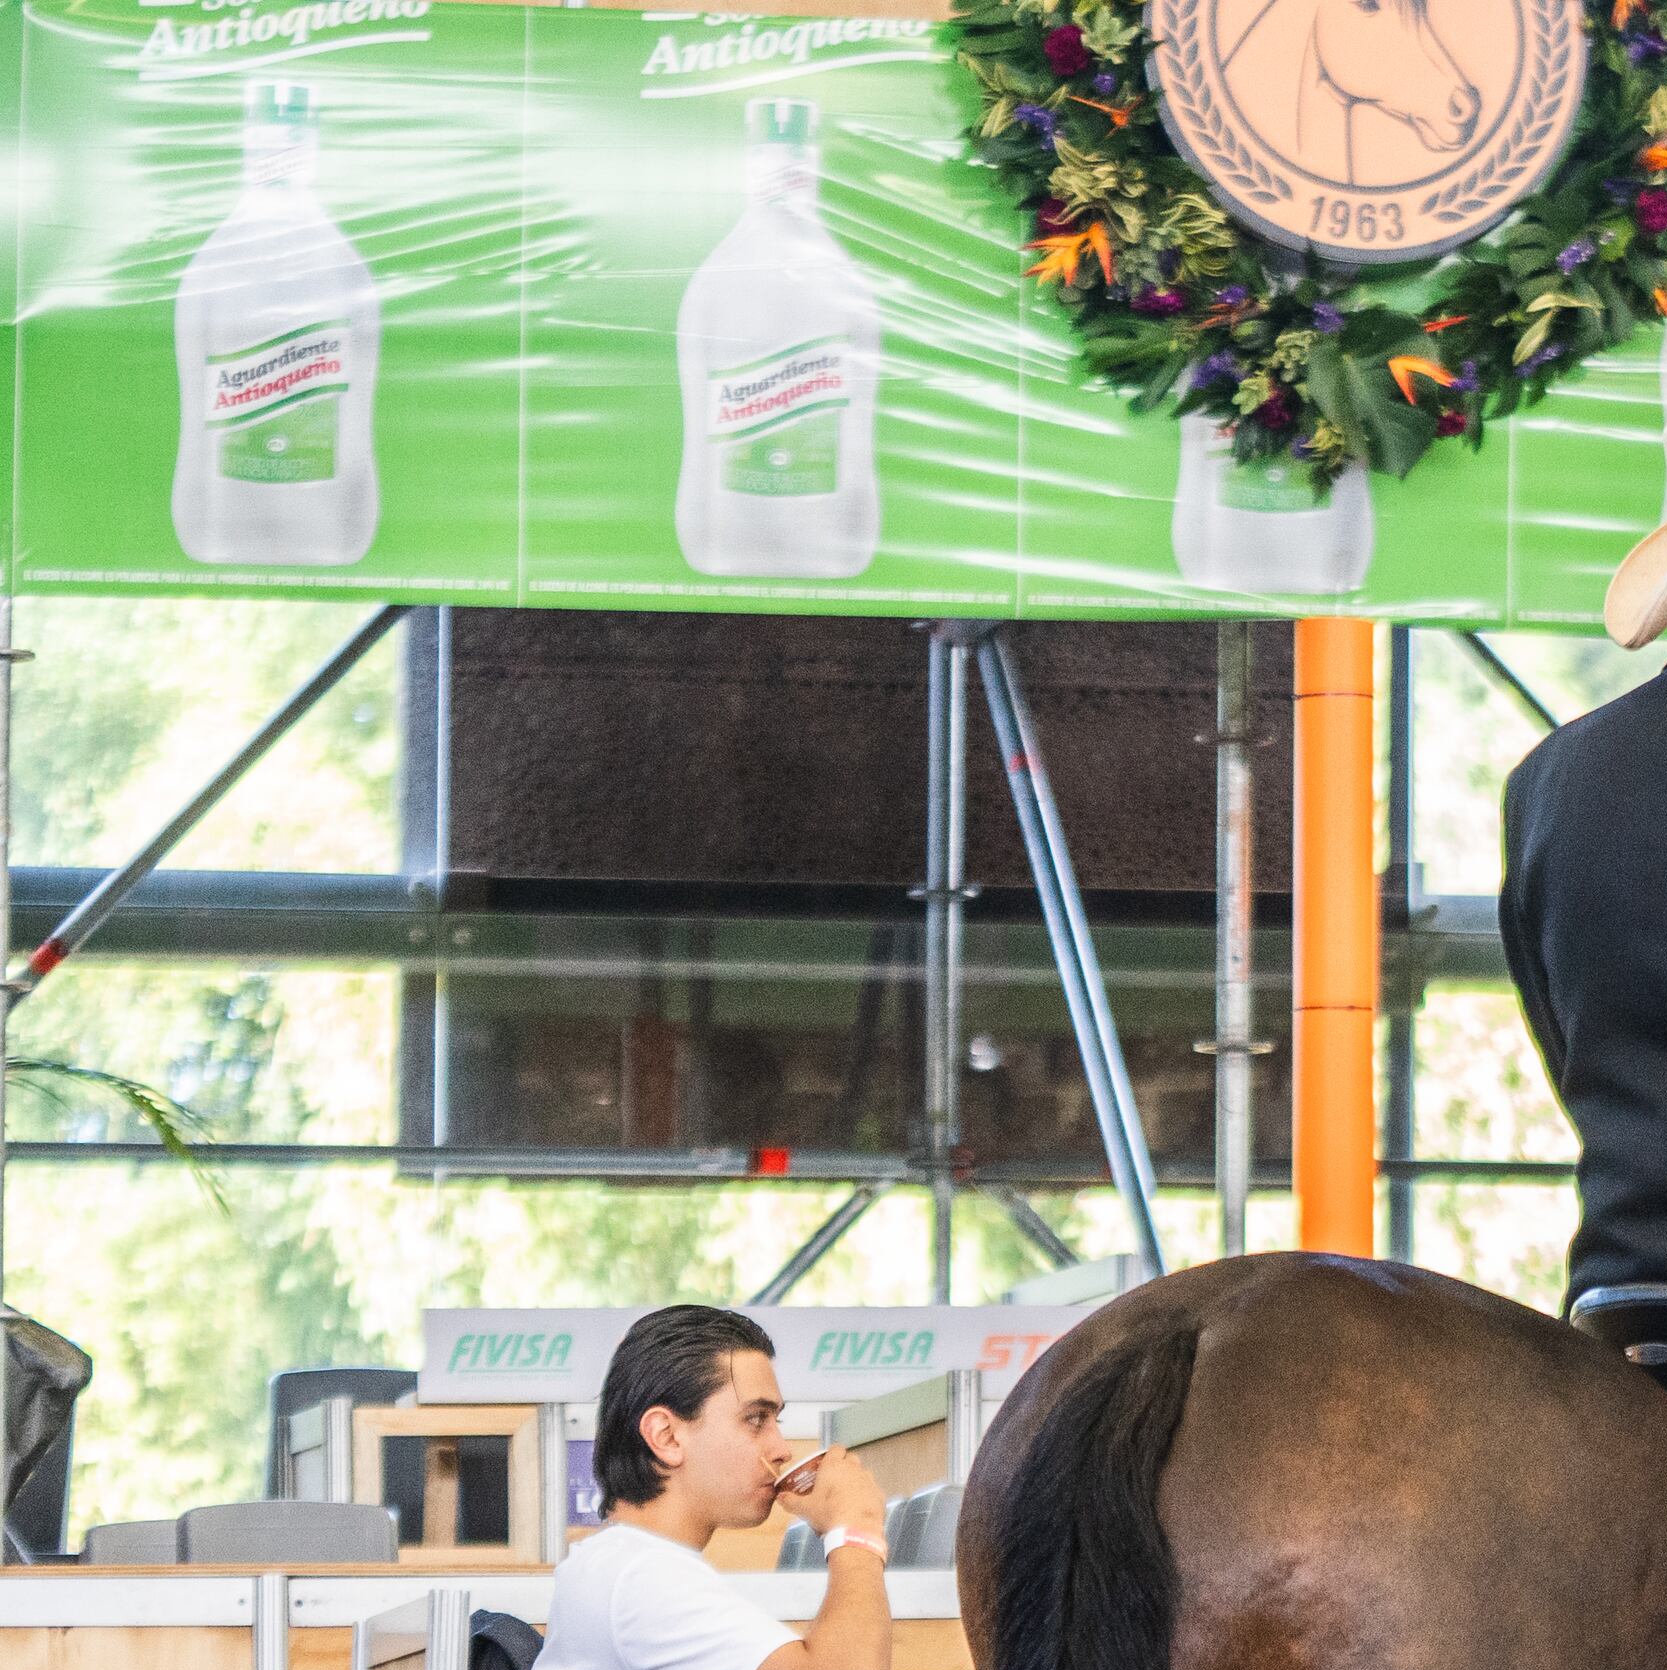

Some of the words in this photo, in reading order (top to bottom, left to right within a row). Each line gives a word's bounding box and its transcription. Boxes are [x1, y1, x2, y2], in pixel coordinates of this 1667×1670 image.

[1310, 196, 1405, 242] 1963
[214, 357, 341, 409] Antioqueño
[217, 340, 339, 388] Aguardiente
[720, 356, 840, 402] Aguardiente
[717, 372, 843, 424] Antioqueño
[447, 1333, 573, 1374] FIVISA
[809, 1330, 937, 1371] FIVISA
